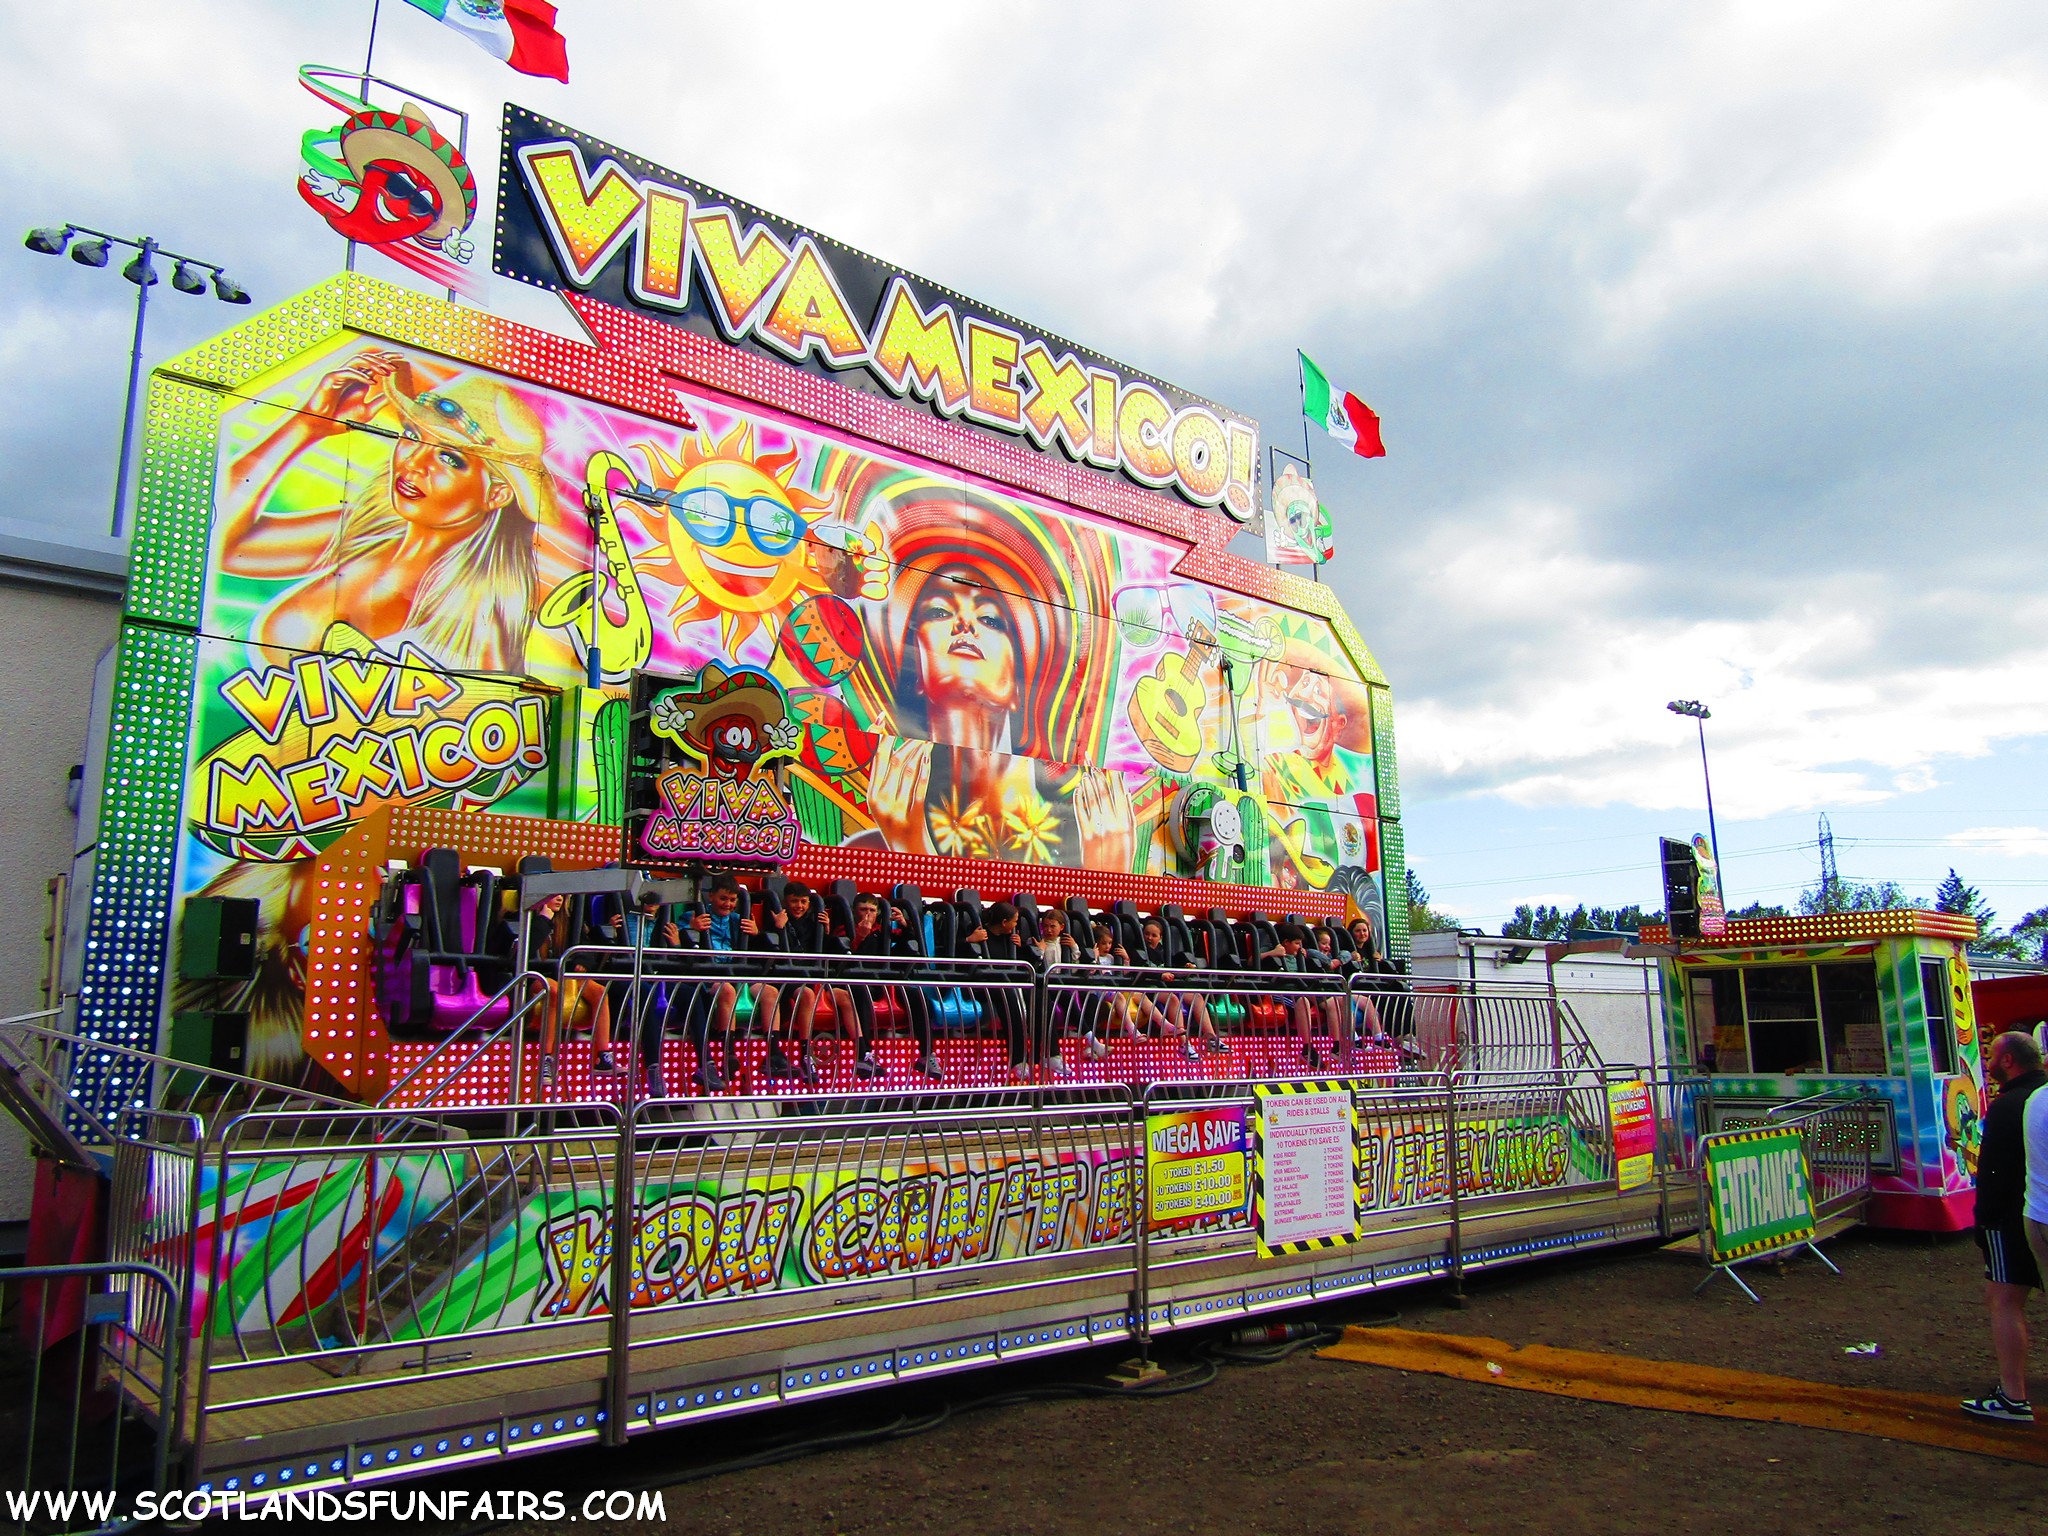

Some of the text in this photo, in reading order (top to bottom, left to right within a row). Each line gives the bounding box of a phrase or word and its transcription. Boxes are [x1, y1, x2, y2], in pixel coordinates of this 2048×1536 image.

[519, 140, 1259, 521] VIVA MEXICO!
[222, 643, 463, 743] VIVA
[210, 696, 552, 833] MEXICO!
[662, 775, 791, 821] VIVA
[647, 818, 801, 859] MEXICO!
[1266, 1099, 1290, 1107] TOKENS
[1291, 1098, 1303, 1107] CAN
[1313, 1097, 1327, 1105] USED
[1329, 1096, 1337, 1104] ON
[1286, 1108, 1304, 1117] RIDES
[1310, 1107, 1330, 1115] STALLS
[1152, 1119, 1241, 1154] MEGA SAVE
[1269, 1125, 1345, 1138] INDIVIDUALLY TOKENS £1.50
[1284, 1139, 1308, 1148] TOKENS
[1318, 1137, 1332, 1145] SAVE
[1164, 1159, 1224, 1179] 1 TOKEN £1.50
[1156, 1187, 1164, 1195] 10
[1166, 1182, 1192, 1193] TOKENS
[1194, 1175, 1231, 1192] £10.00
[1715, 1149, 1807, 1236] ENTRANCE
[1155, 1202, 1164, 1212] 50
[1166, 1197, 1192, 1209] TOKENS
[1194, 1191, 1232, 1208] £40.00
[1274, 1199, 1302, 1208] INFLATABLES
[1293, 1212, 1322, 1221] TRAMPOLINES
[536, 1192, 802, 1319] YOU
